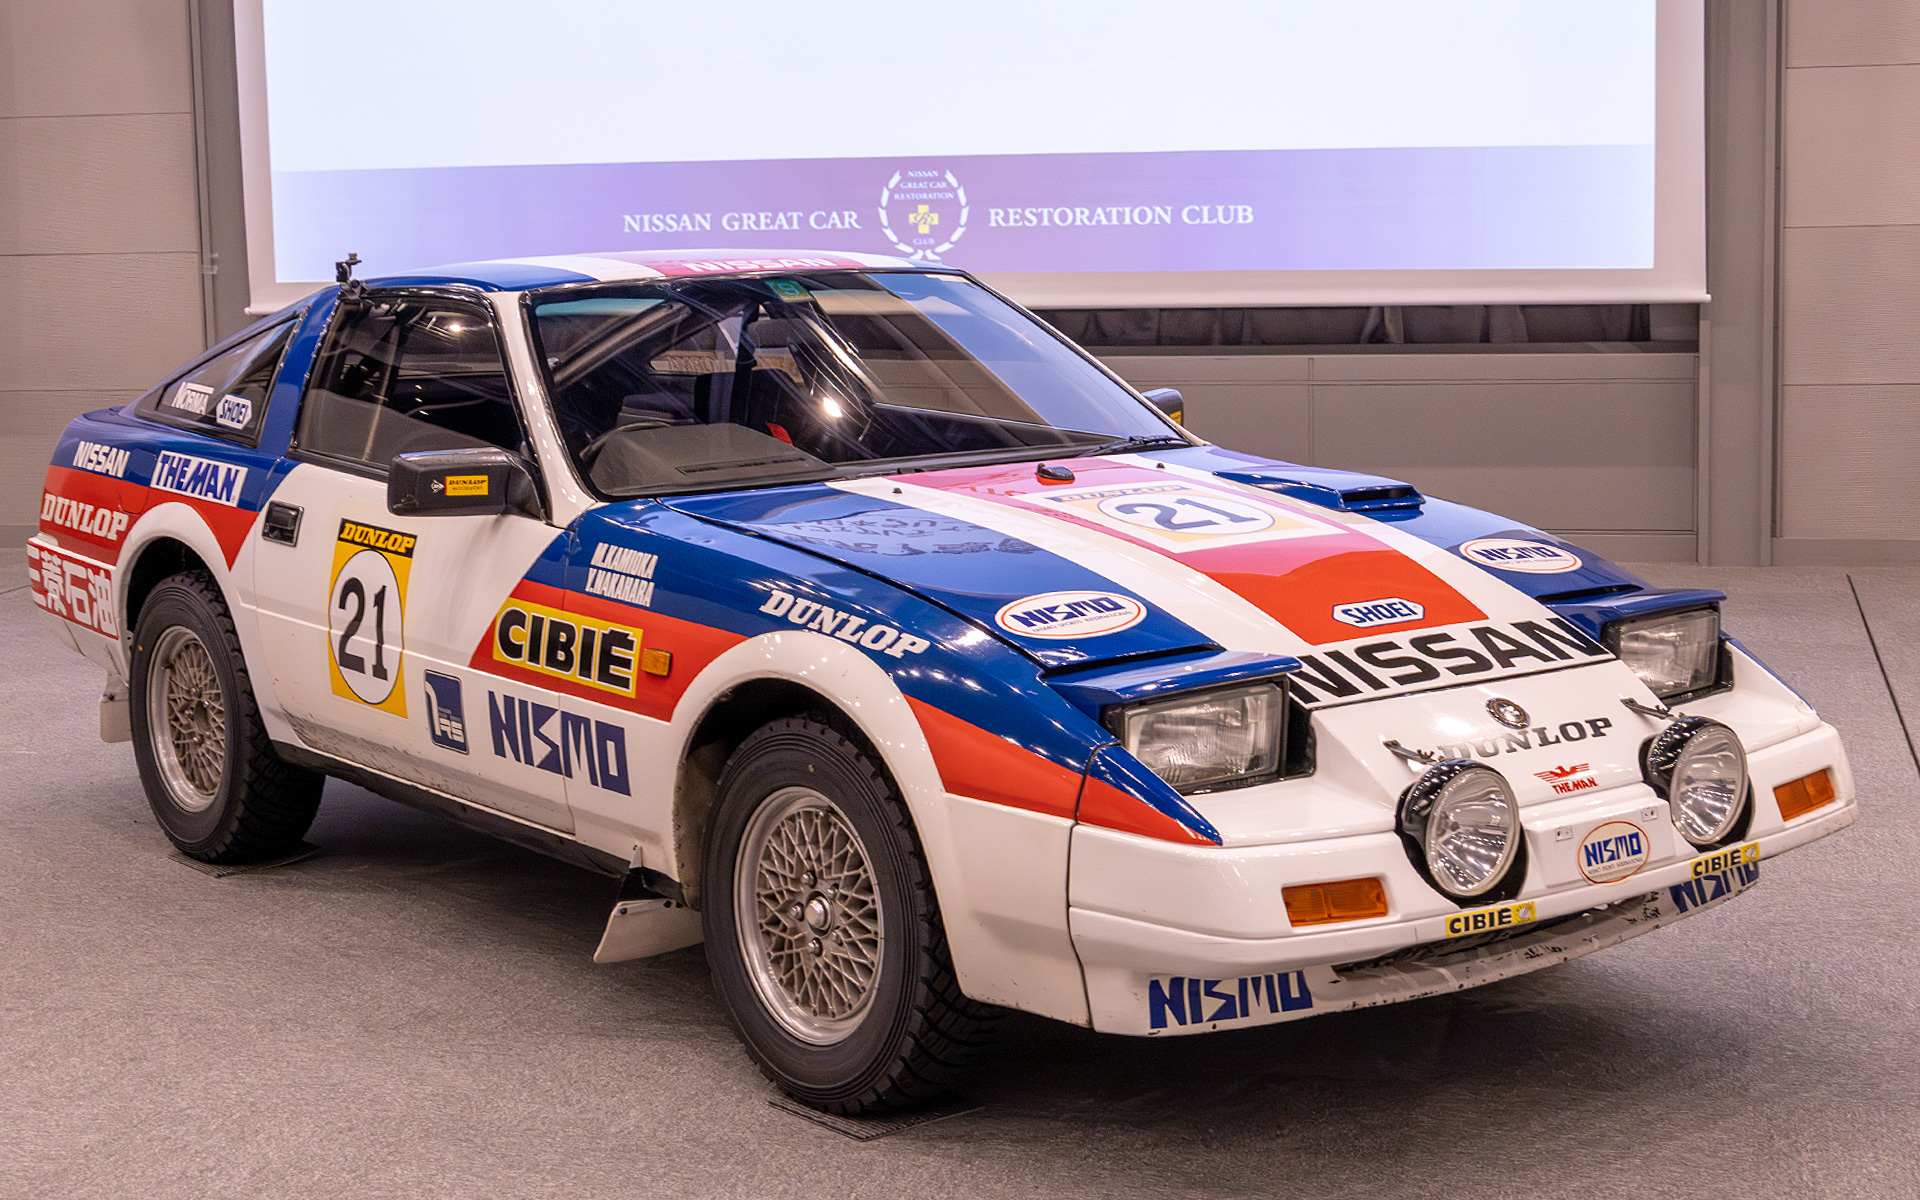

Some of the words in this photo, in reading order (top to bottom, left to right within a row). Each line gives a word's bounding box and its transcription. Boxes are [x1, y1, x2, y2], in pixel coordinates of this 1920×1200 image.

[623, 213, 712, 232] NISSAN
[721, 212, 803, 231] GREAT
[809, 211, 863, 230] CAR
[988, 206, 1173, 227] RESTORATION
[1181, 205, 1255, 225] CLUB
[683, 259, 838, 272] NISSAN
[171, 382, 214, 415] NORMA
[219, 399, 249, 424] SHOEI
[73, 441, 131, 478] NISSAN
[1057, 485, 1187, 501] DUNLOP
[41, 493, 129, 541] DUNLOP
[1115, 498, 1261, 530] 21
[340, 523, 415, 553] DUNLOP
[1471, 547, 1563, 560] NISMO
[759, 589, 931, 659] DUNLOP
[1009, 597, 1126, 627] NISMO
[1341, 601, 1418, 623] SHOEI
[338, 577, 388, 681] 21
[1287, 617, 1609, 703] NISSAN
[488, 691, 631, 796] NISMO
[1437, 717, 1612, 759] DUNLOP
[1584, 832, 1642, 867] NISMO
[1149, 970, 1313, 1029] NISMO
